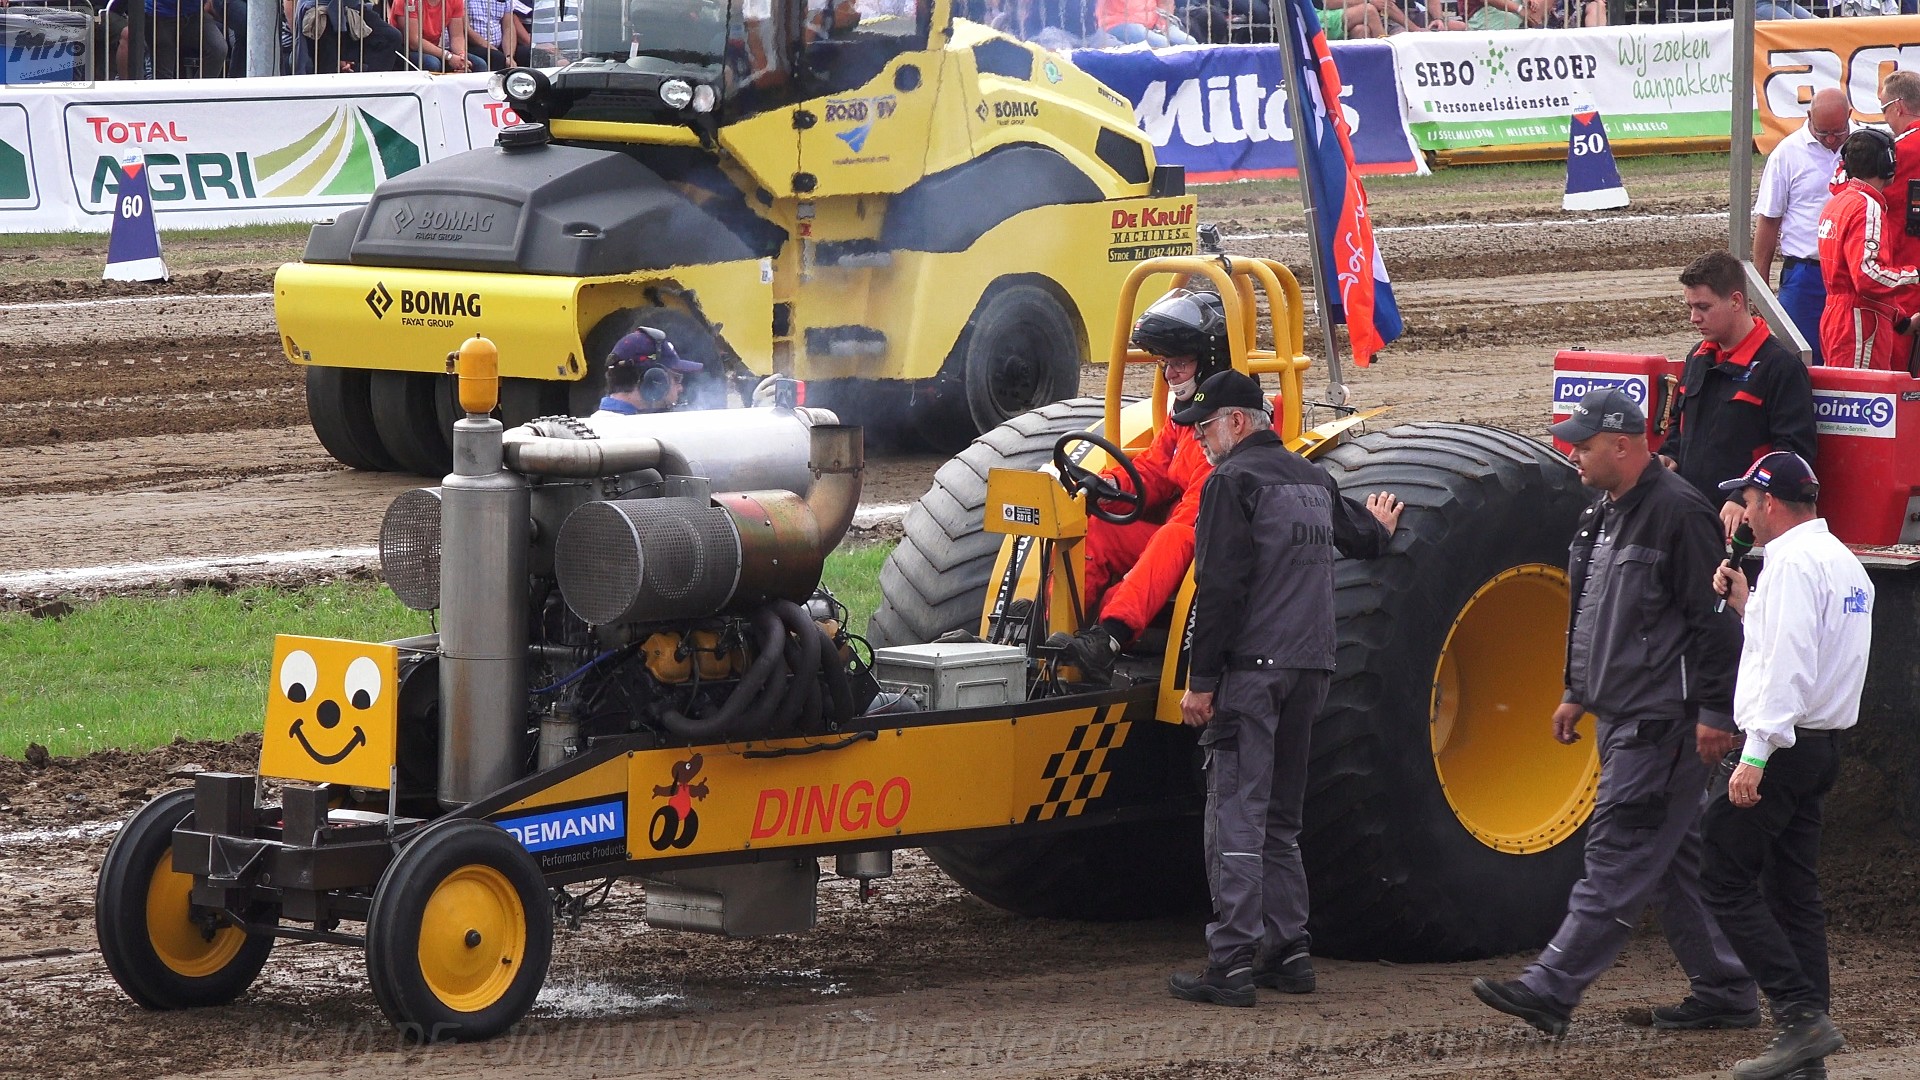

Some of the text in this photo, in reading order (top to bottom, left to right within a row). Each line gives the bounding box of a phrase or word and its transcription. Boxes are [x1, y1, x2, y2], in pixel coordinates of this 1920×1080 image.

[1618, 30, 1711, 77] Wij zoeken
[1415, 54, 1598, 87] SEBO GROEP
[1633, 62, 1733, 109] aanpakkers
[993, 100, 1039, 118] BOMAG
[1435, 95, 1570, 114] Personeelsdiensten
[87, 117, 188, 144] TOTAL
[1505, 125, 1549, 137] NIJKERK
[1622, 121, 1669, 133] MARKELO
[1573, 133, 1604, 156] 50
[91, 152, 257, 204] AGRI
[121, 194, 143, 219] 60
[417, 209, 495, 233] BOMAG
[438, 233, 463, 241] GROUP
[1113, 228, 1182, 244] MACHINES
[401, 290, 481, 317] BOMAG
[402, 317, 454, 328] FAYAT GROUP
[1016, 513, 1032, 522] 2016
[751, 776, 911, 840] DINGO
[542, 843, 625, 868] Performance Products
